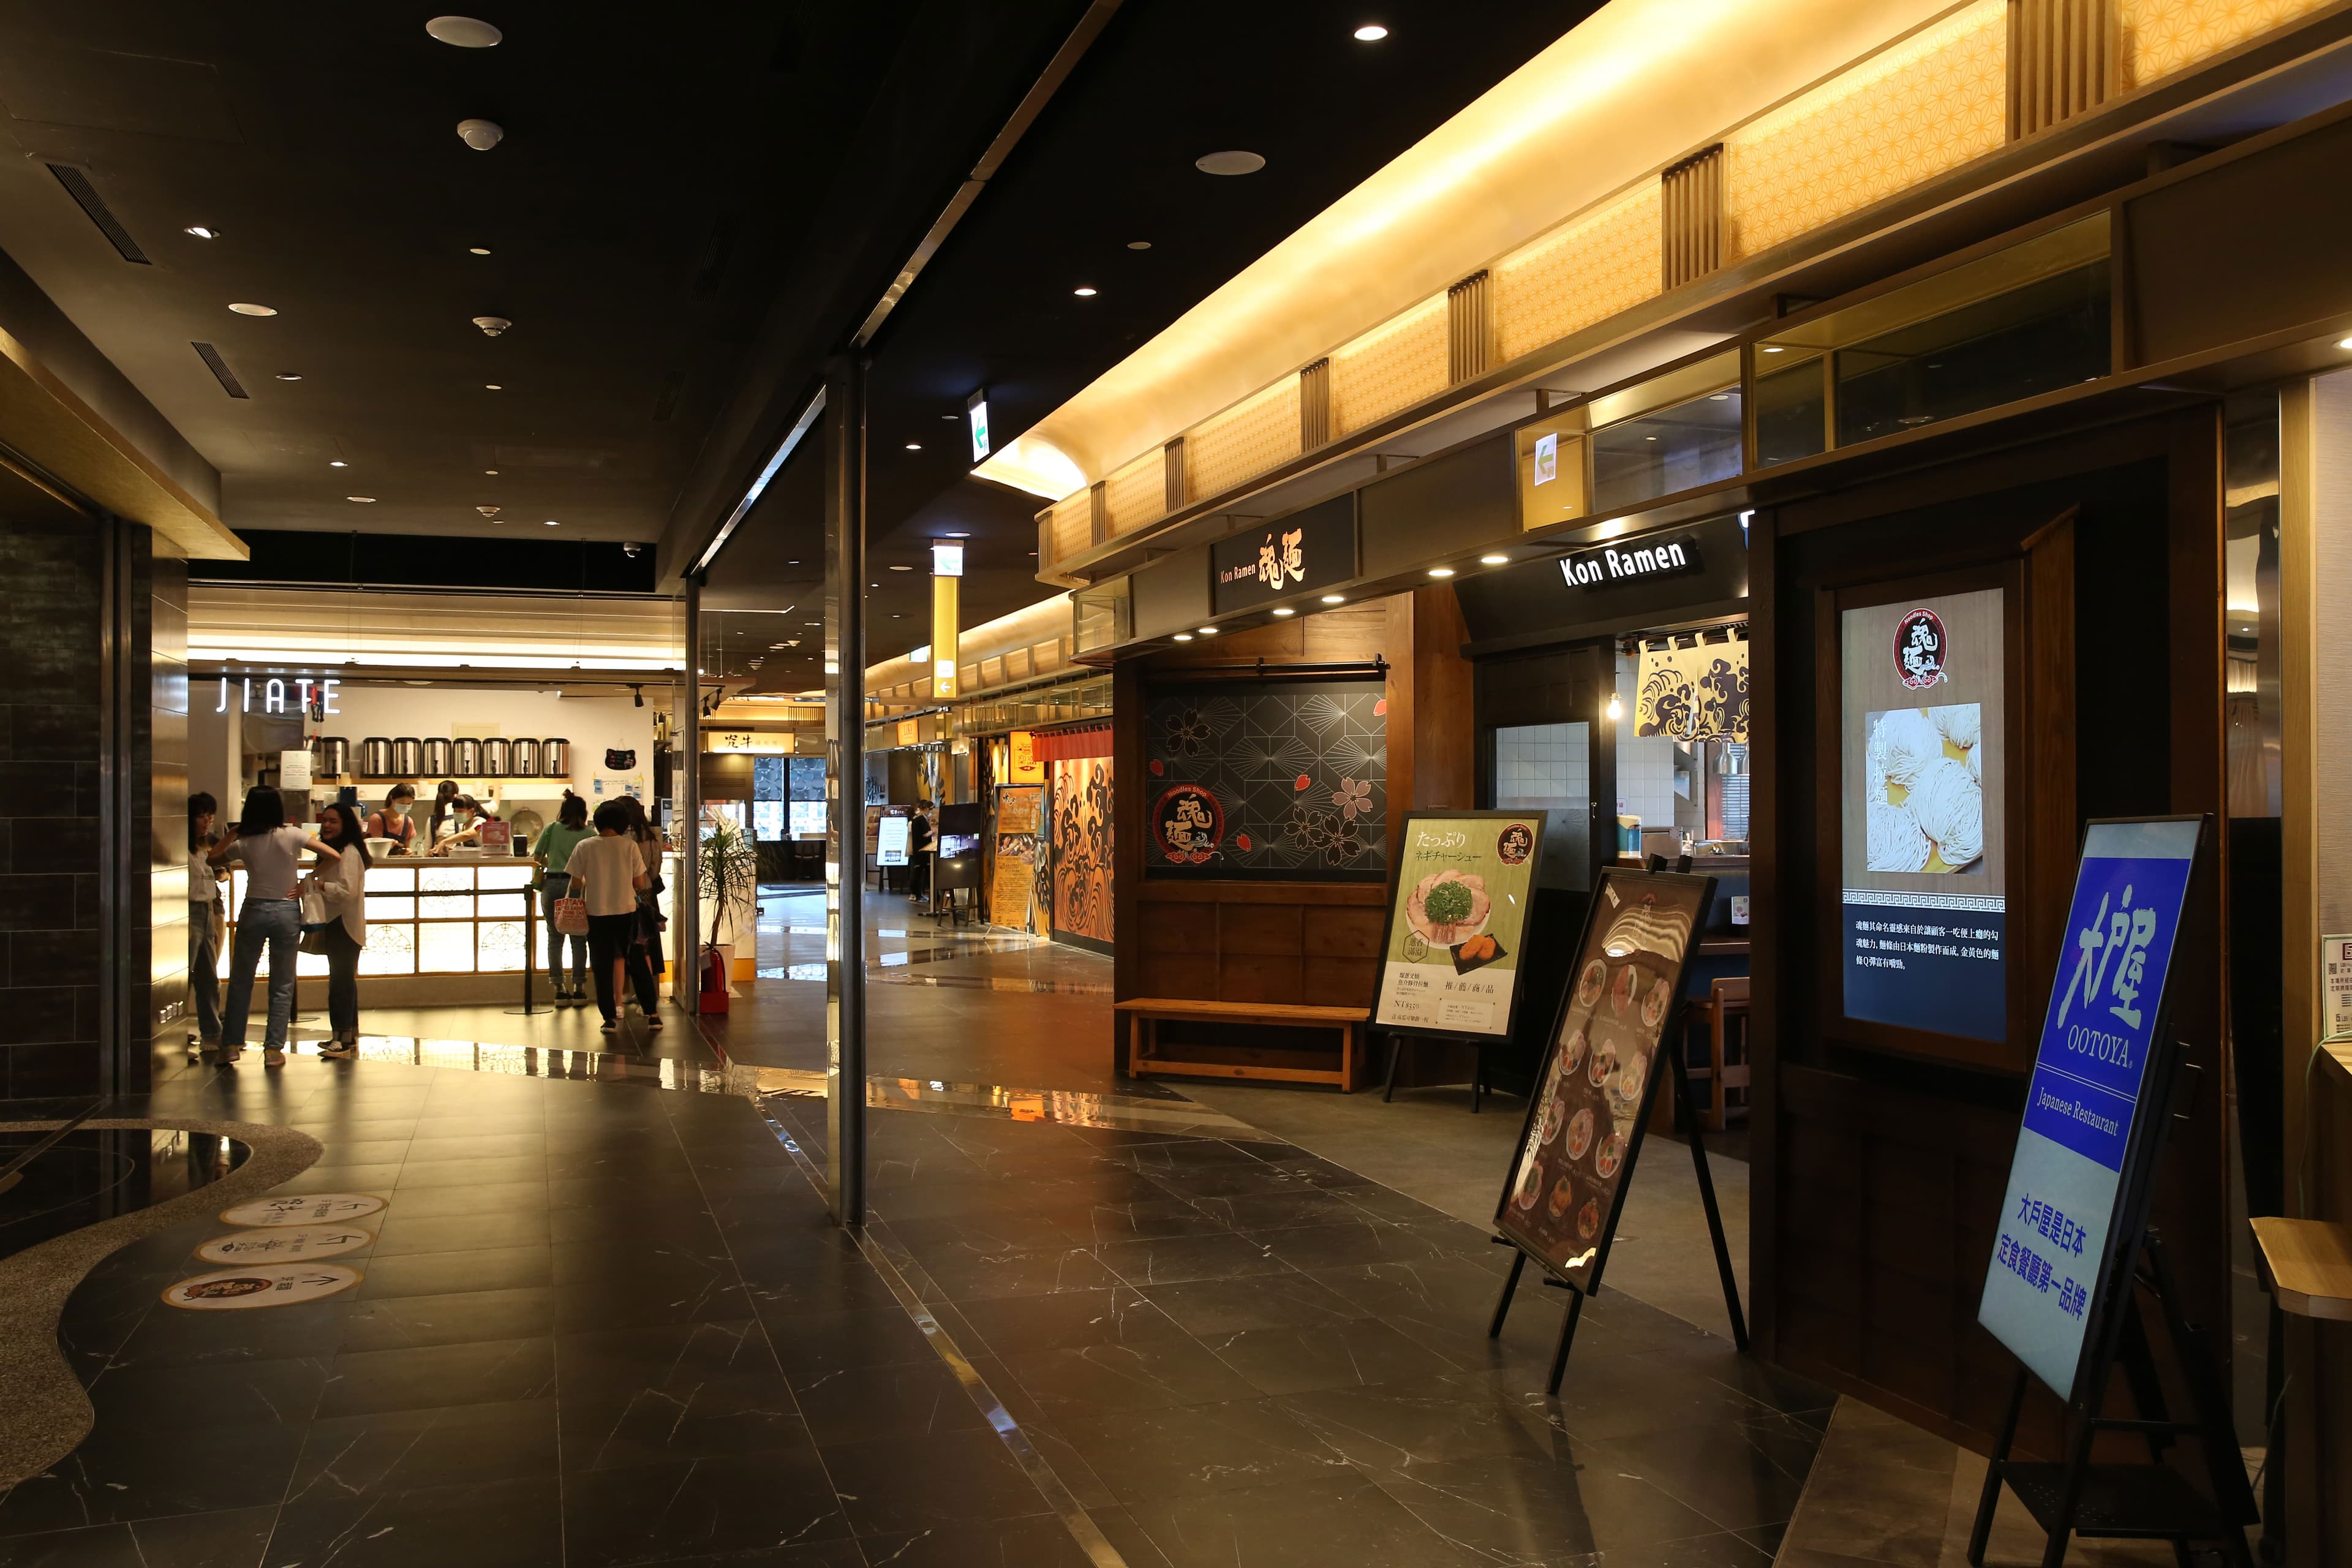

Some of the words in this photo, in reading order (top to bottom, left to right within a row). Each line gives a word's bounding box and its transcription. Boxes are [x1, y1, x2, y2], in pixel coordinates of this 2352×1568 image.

[1220, 570, 1232, 584] Kon
[1234, 564, 1256, 580] Ramen
[1560, 559, 1603, 586] Kon
[1605, 543, 1686, 578] Ramen
[1904, 612, 1921, 624] Noodles
[1922, 611, 1934, 620] Shop
[216, 677, 341, 714] JIATE
[1873, 718, 1888, 805] 特製拉麵
[1168, 786, 1191, 797] Noodles
[1192, 786, 1207, 797] Shop
[1416, 831, 1466, 848] たっぷり
[1415, 850, 1482, 862] ネギチャーシュー
[1394, 1000, 1420, 1011] NT$350
[2068, 1025, 2128, 1068] OOTOYA
[2037, 1087, 2072, 1116] Japanese
[2073, 1101, 2119, 1136] Restaurant
[1997, 1233, 2087, 1321] 定食餐廳第一品牌
